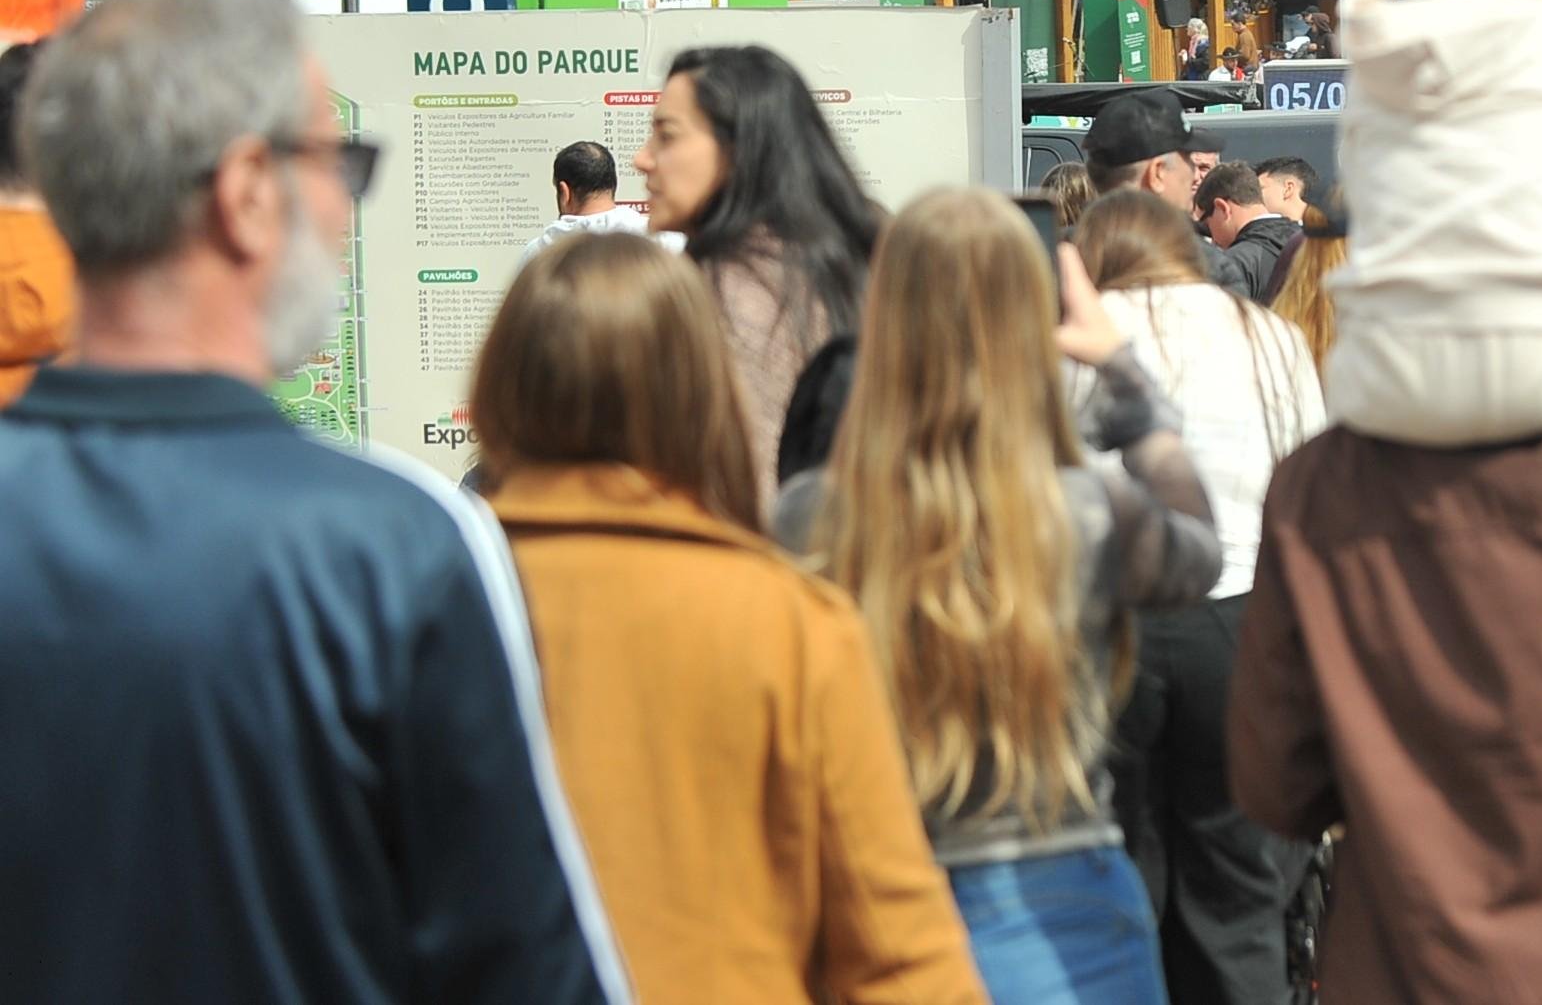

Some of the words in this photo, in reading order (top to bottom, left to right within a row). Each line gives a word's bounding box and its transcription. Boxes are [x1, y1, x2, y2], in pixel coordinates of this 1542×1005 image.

[414, 51, 486, 75] MAPA
[495, 50, 528, 74] DO
[538, 48, 639, 74] PARQUE
[419, 95, 459, 106] PORTÕES
[460, 97, 466, 105] E
[467, 97, 514, 105] ENTRADAS
[610, 95, 640, 103] PISTAS
[423, 271, 473, 280] PAVILHÕES
